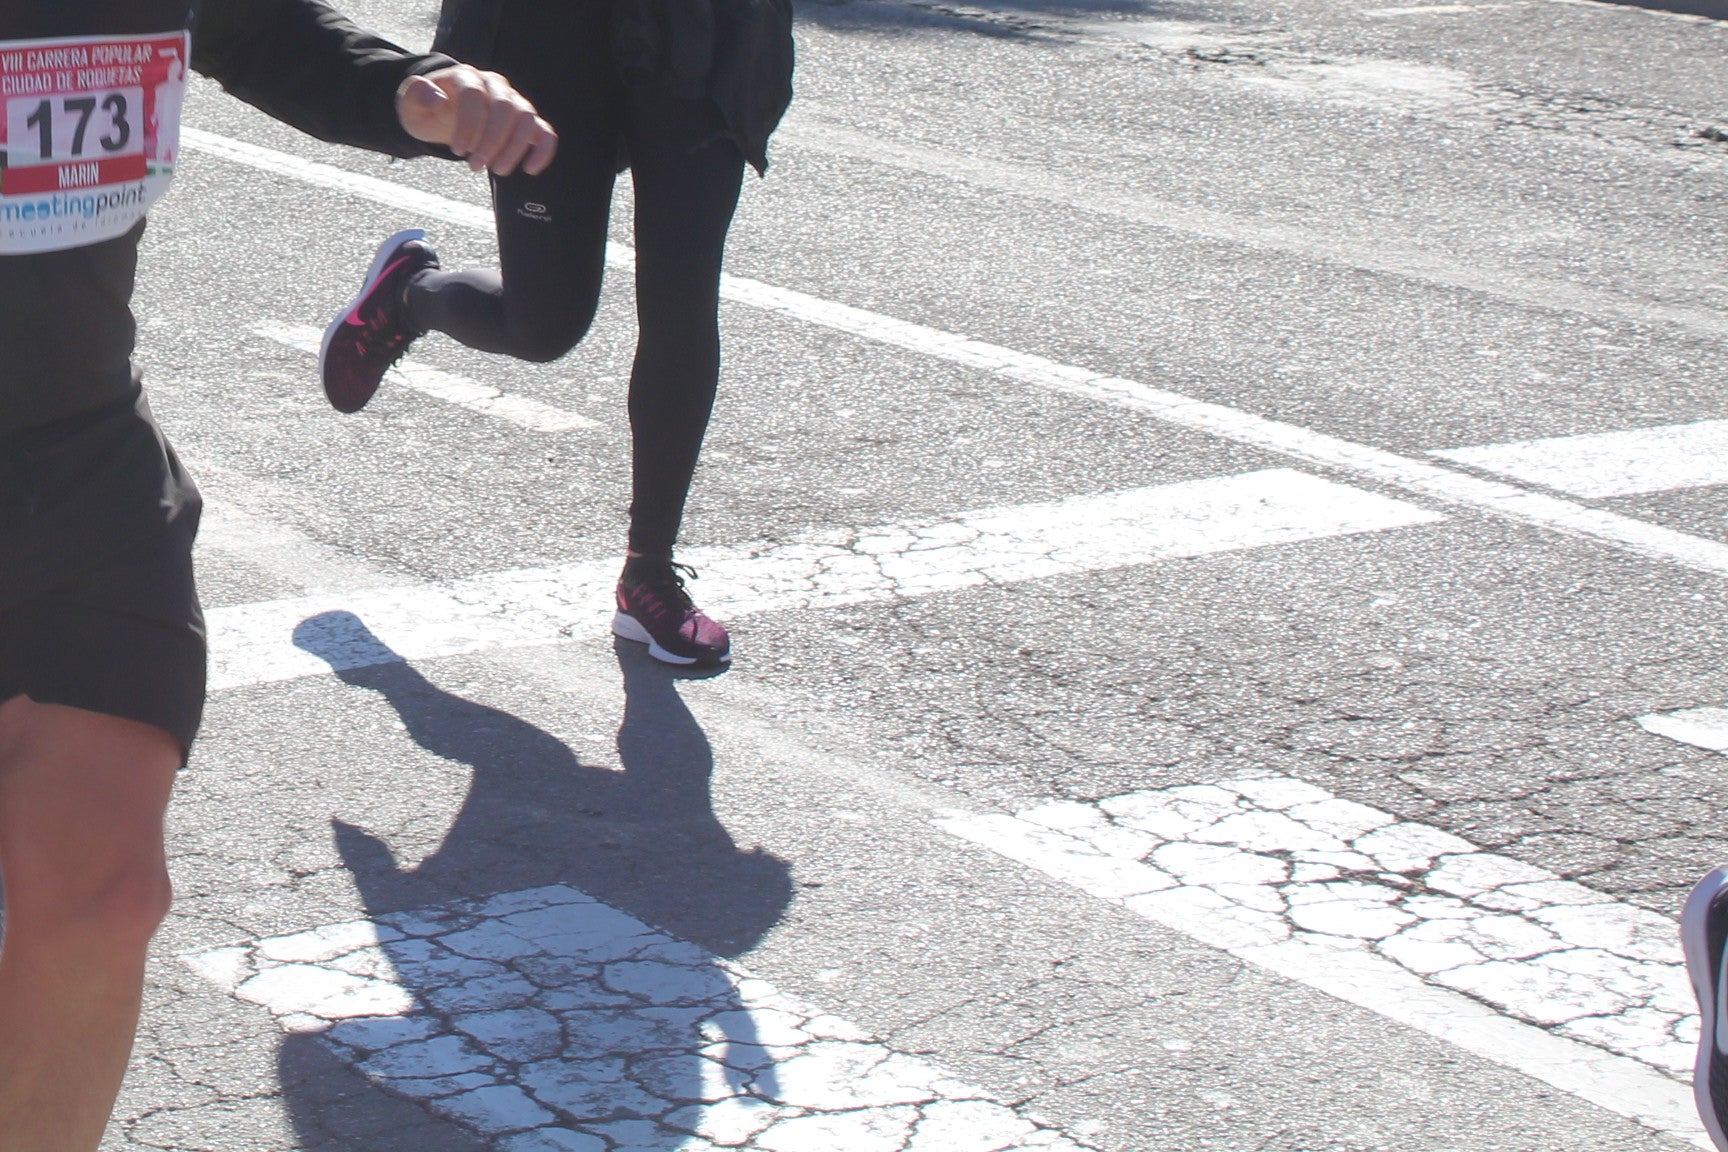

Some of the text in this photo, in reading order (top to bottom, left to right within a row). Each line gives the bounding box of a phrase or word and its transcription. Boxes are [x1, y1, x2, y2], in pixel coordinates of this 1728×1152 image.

[2, 44, 152, 72] VIII CARRERA POPULAR
[2, 65, 142, 95] CIUDAD DE ROQUETAS
[27, 92, 130, 158] 173
[58, 162, 99, 188] MARIN
